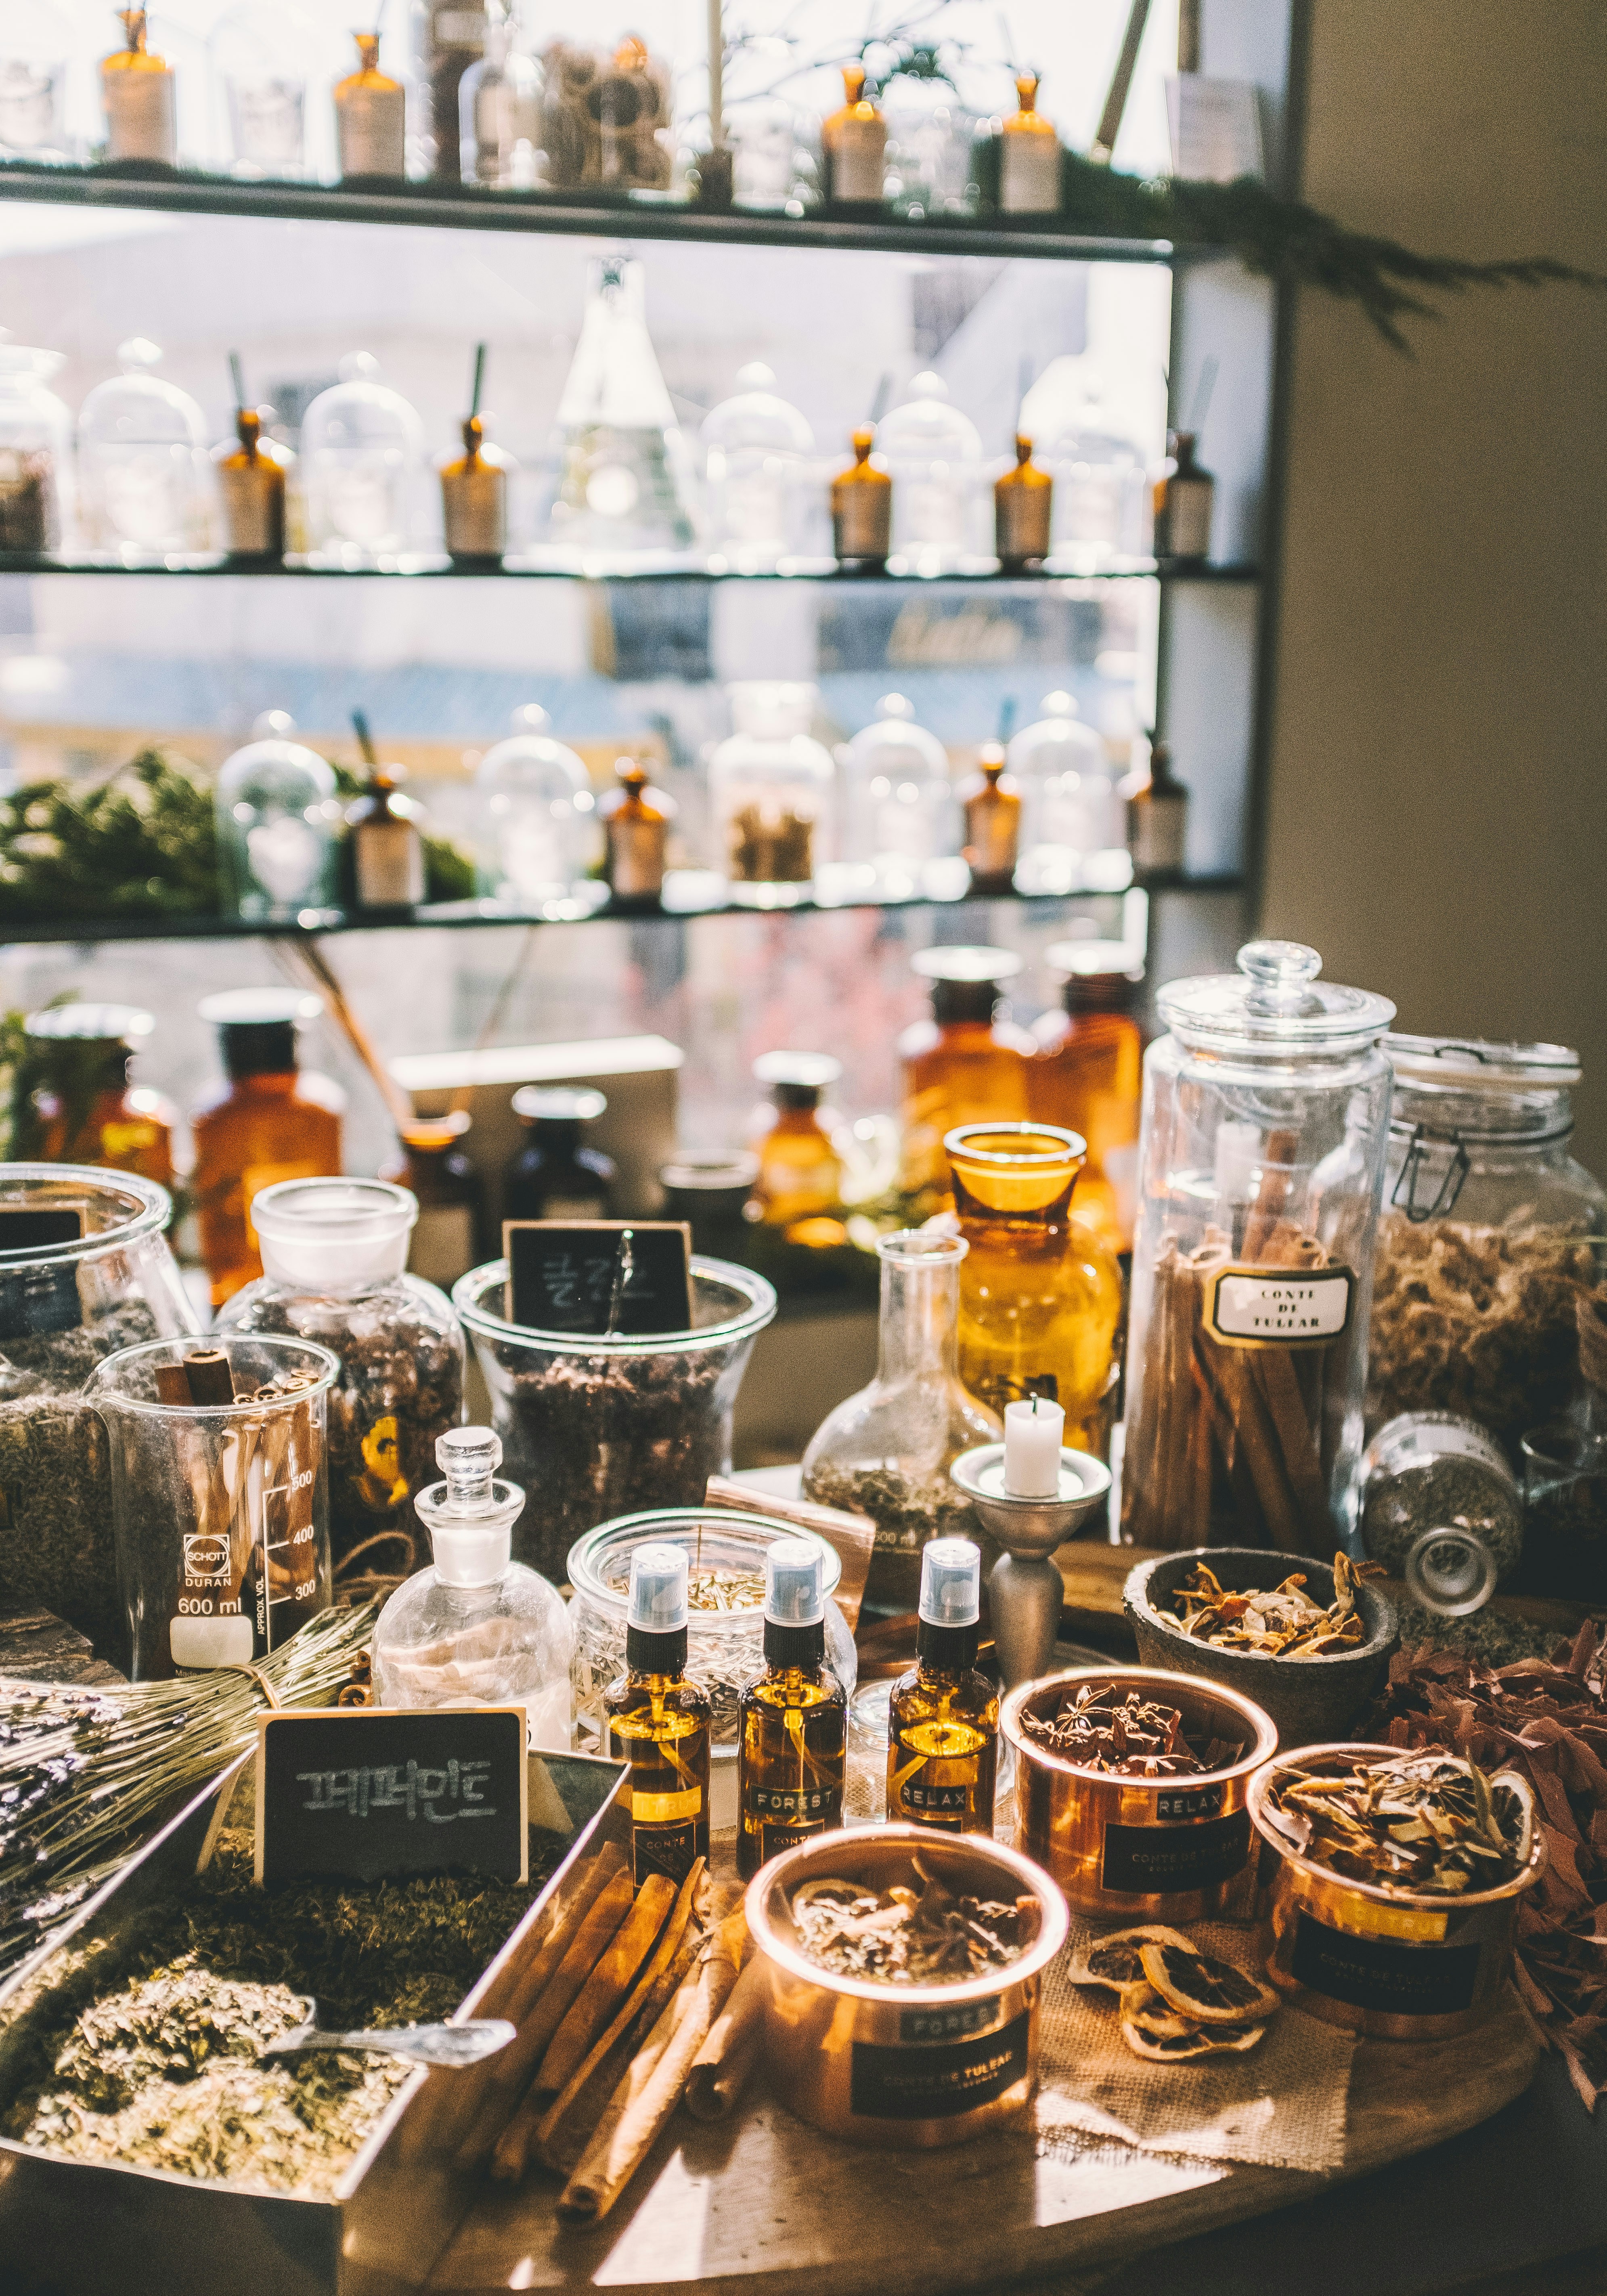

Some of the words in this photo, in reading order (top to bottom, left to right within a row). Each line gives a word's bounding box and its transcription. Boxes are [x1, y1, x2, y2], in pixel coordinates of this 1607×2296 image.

[1261, 1290, 1315, 1299] CONTE
[1278, 1304, 1297, 1313] DE
[292, 1470, 312, 1492] 500
[293, 1525, 314, 1545] 400
[187, 1552, 227, 1562] SCHOTT
[185, 1577, 231, 1587] DURAN
[255, 1576, 264, 1596] VOL.
[295, 1580, 316, 1601] 300
[178, 1598, 213, 1614] 600
[220, 1598, 242, 1613] ml
[257, 1598, 265, 1635] APPROX.
[296, 1759, 497, 1824] 페퍼민트
[756, 1790, 832, 1810] FOREST
[903, 1786, 965, 1806] RELAX
[1159, 1795, 1220, 1814] RELAX
[646, 1836, 686, 1849] CONTE
[1131, 1852, 1177, 1864] CONTE
